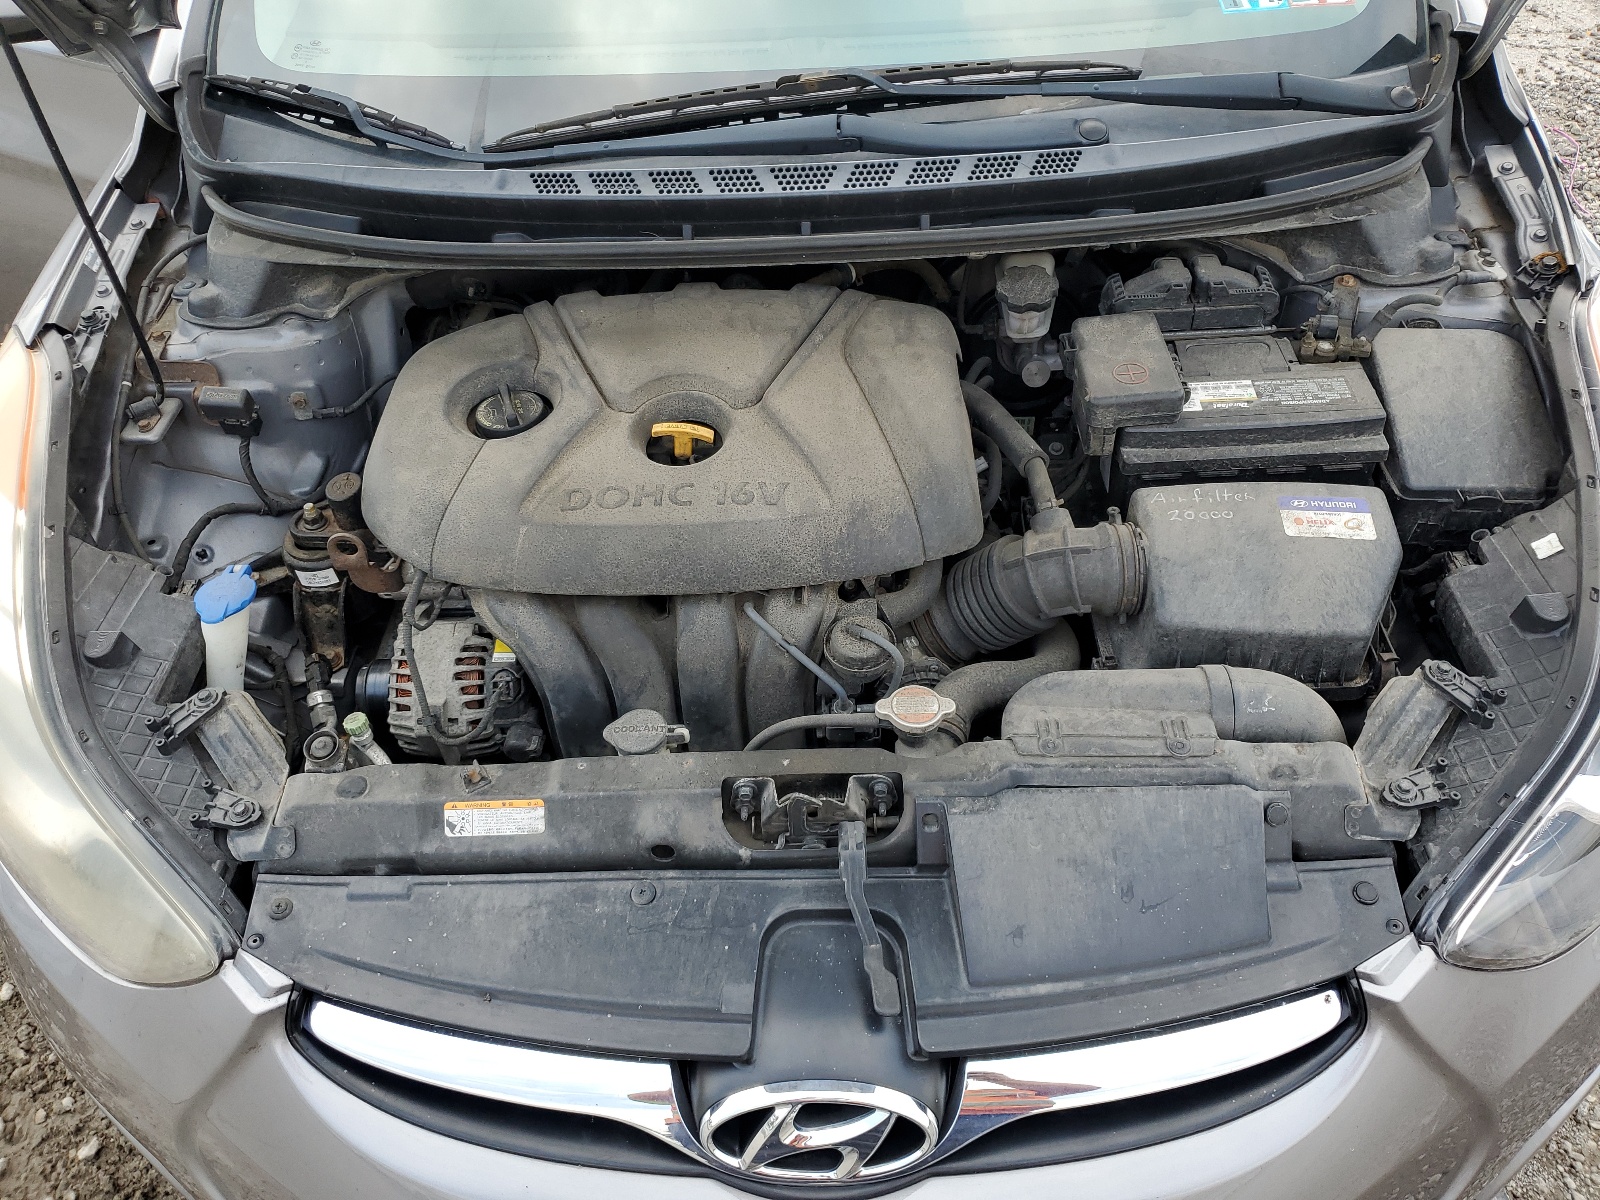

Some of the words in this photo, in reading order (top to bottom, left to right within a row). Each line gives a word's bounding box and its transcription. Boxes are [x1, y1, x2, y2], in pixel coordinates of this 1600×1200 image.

[560, 482, 696, 511] DOHC
[714, 481, 791, 506] 16V
[1310, 501, 1358, 510] HYUNDAI
[1166, 509, 1234, 522] 20000
[613, 724, 666, 734] COOLANT
